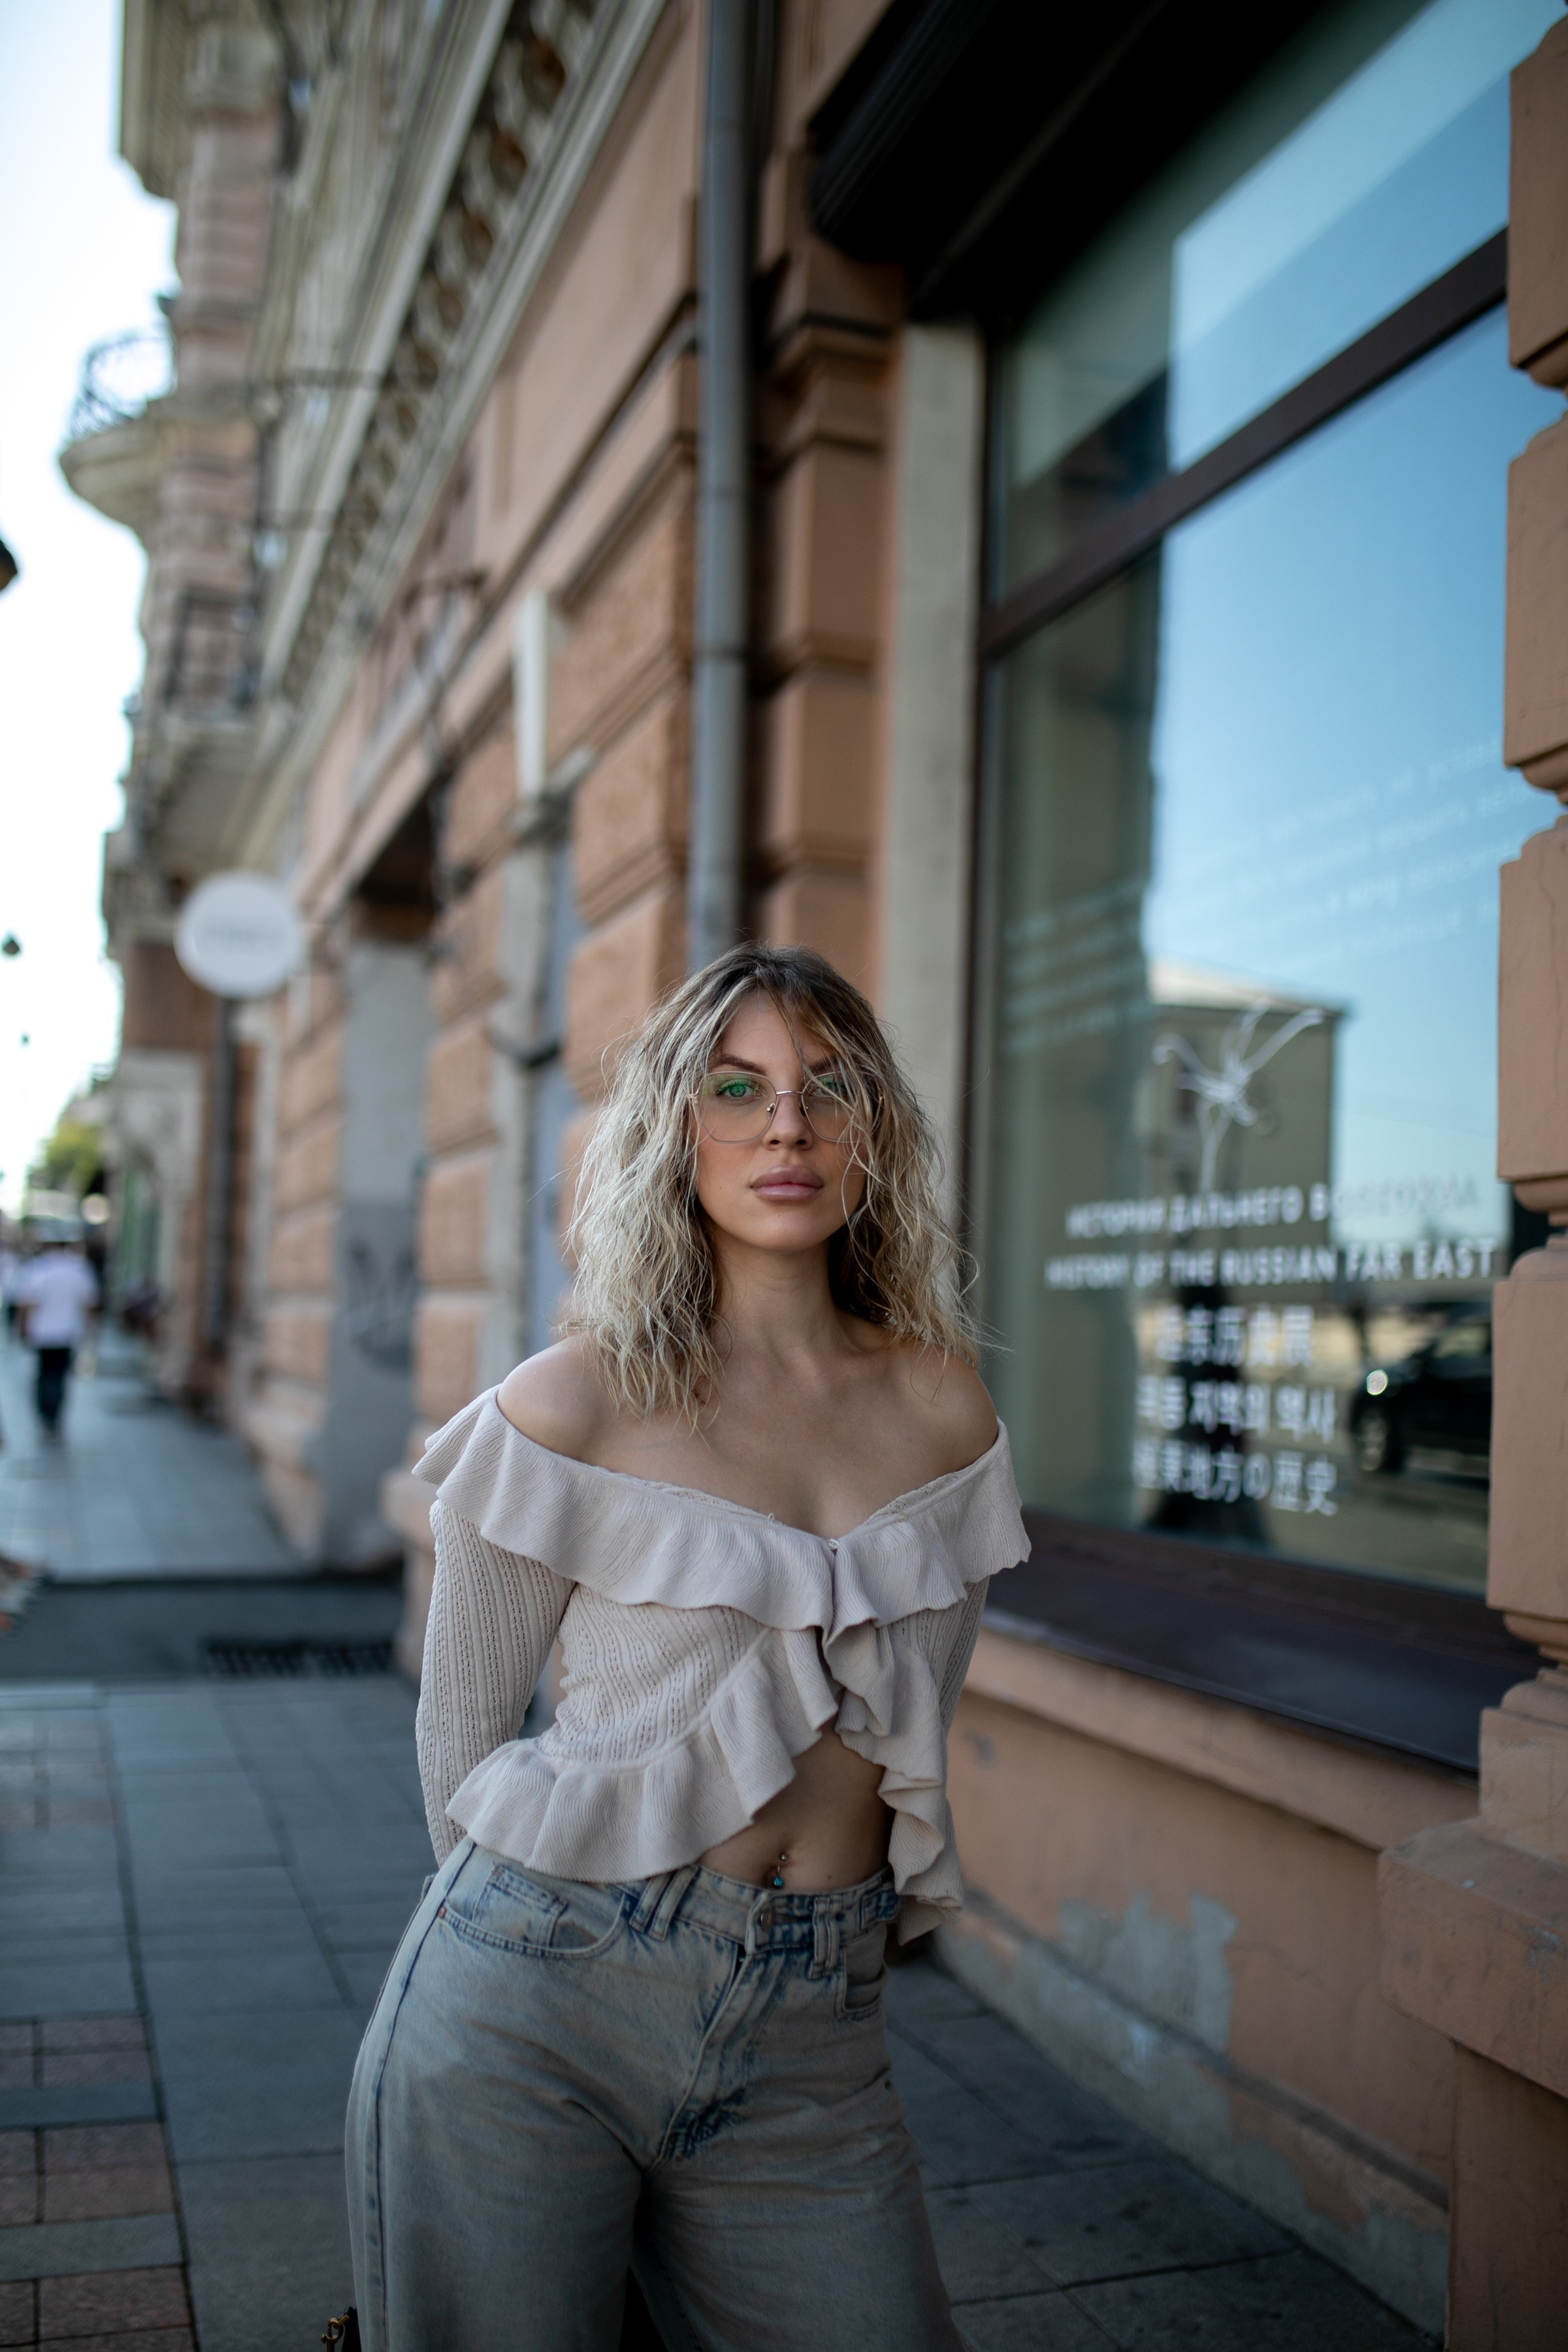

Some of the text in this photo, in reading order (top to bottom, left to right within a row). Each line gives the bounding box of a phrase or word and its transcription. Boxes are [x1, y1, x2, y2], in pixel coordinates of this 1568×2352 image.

[1133, 1250, 1164, 1288] OF
[1169, 1247, 1216, 1287] THE
[1220, 1243, 1337, 1286] RUSSIAN
[1345, 1241, 1403, 1282] FAR
[1412, 1239, 1495, 1280] EAST
